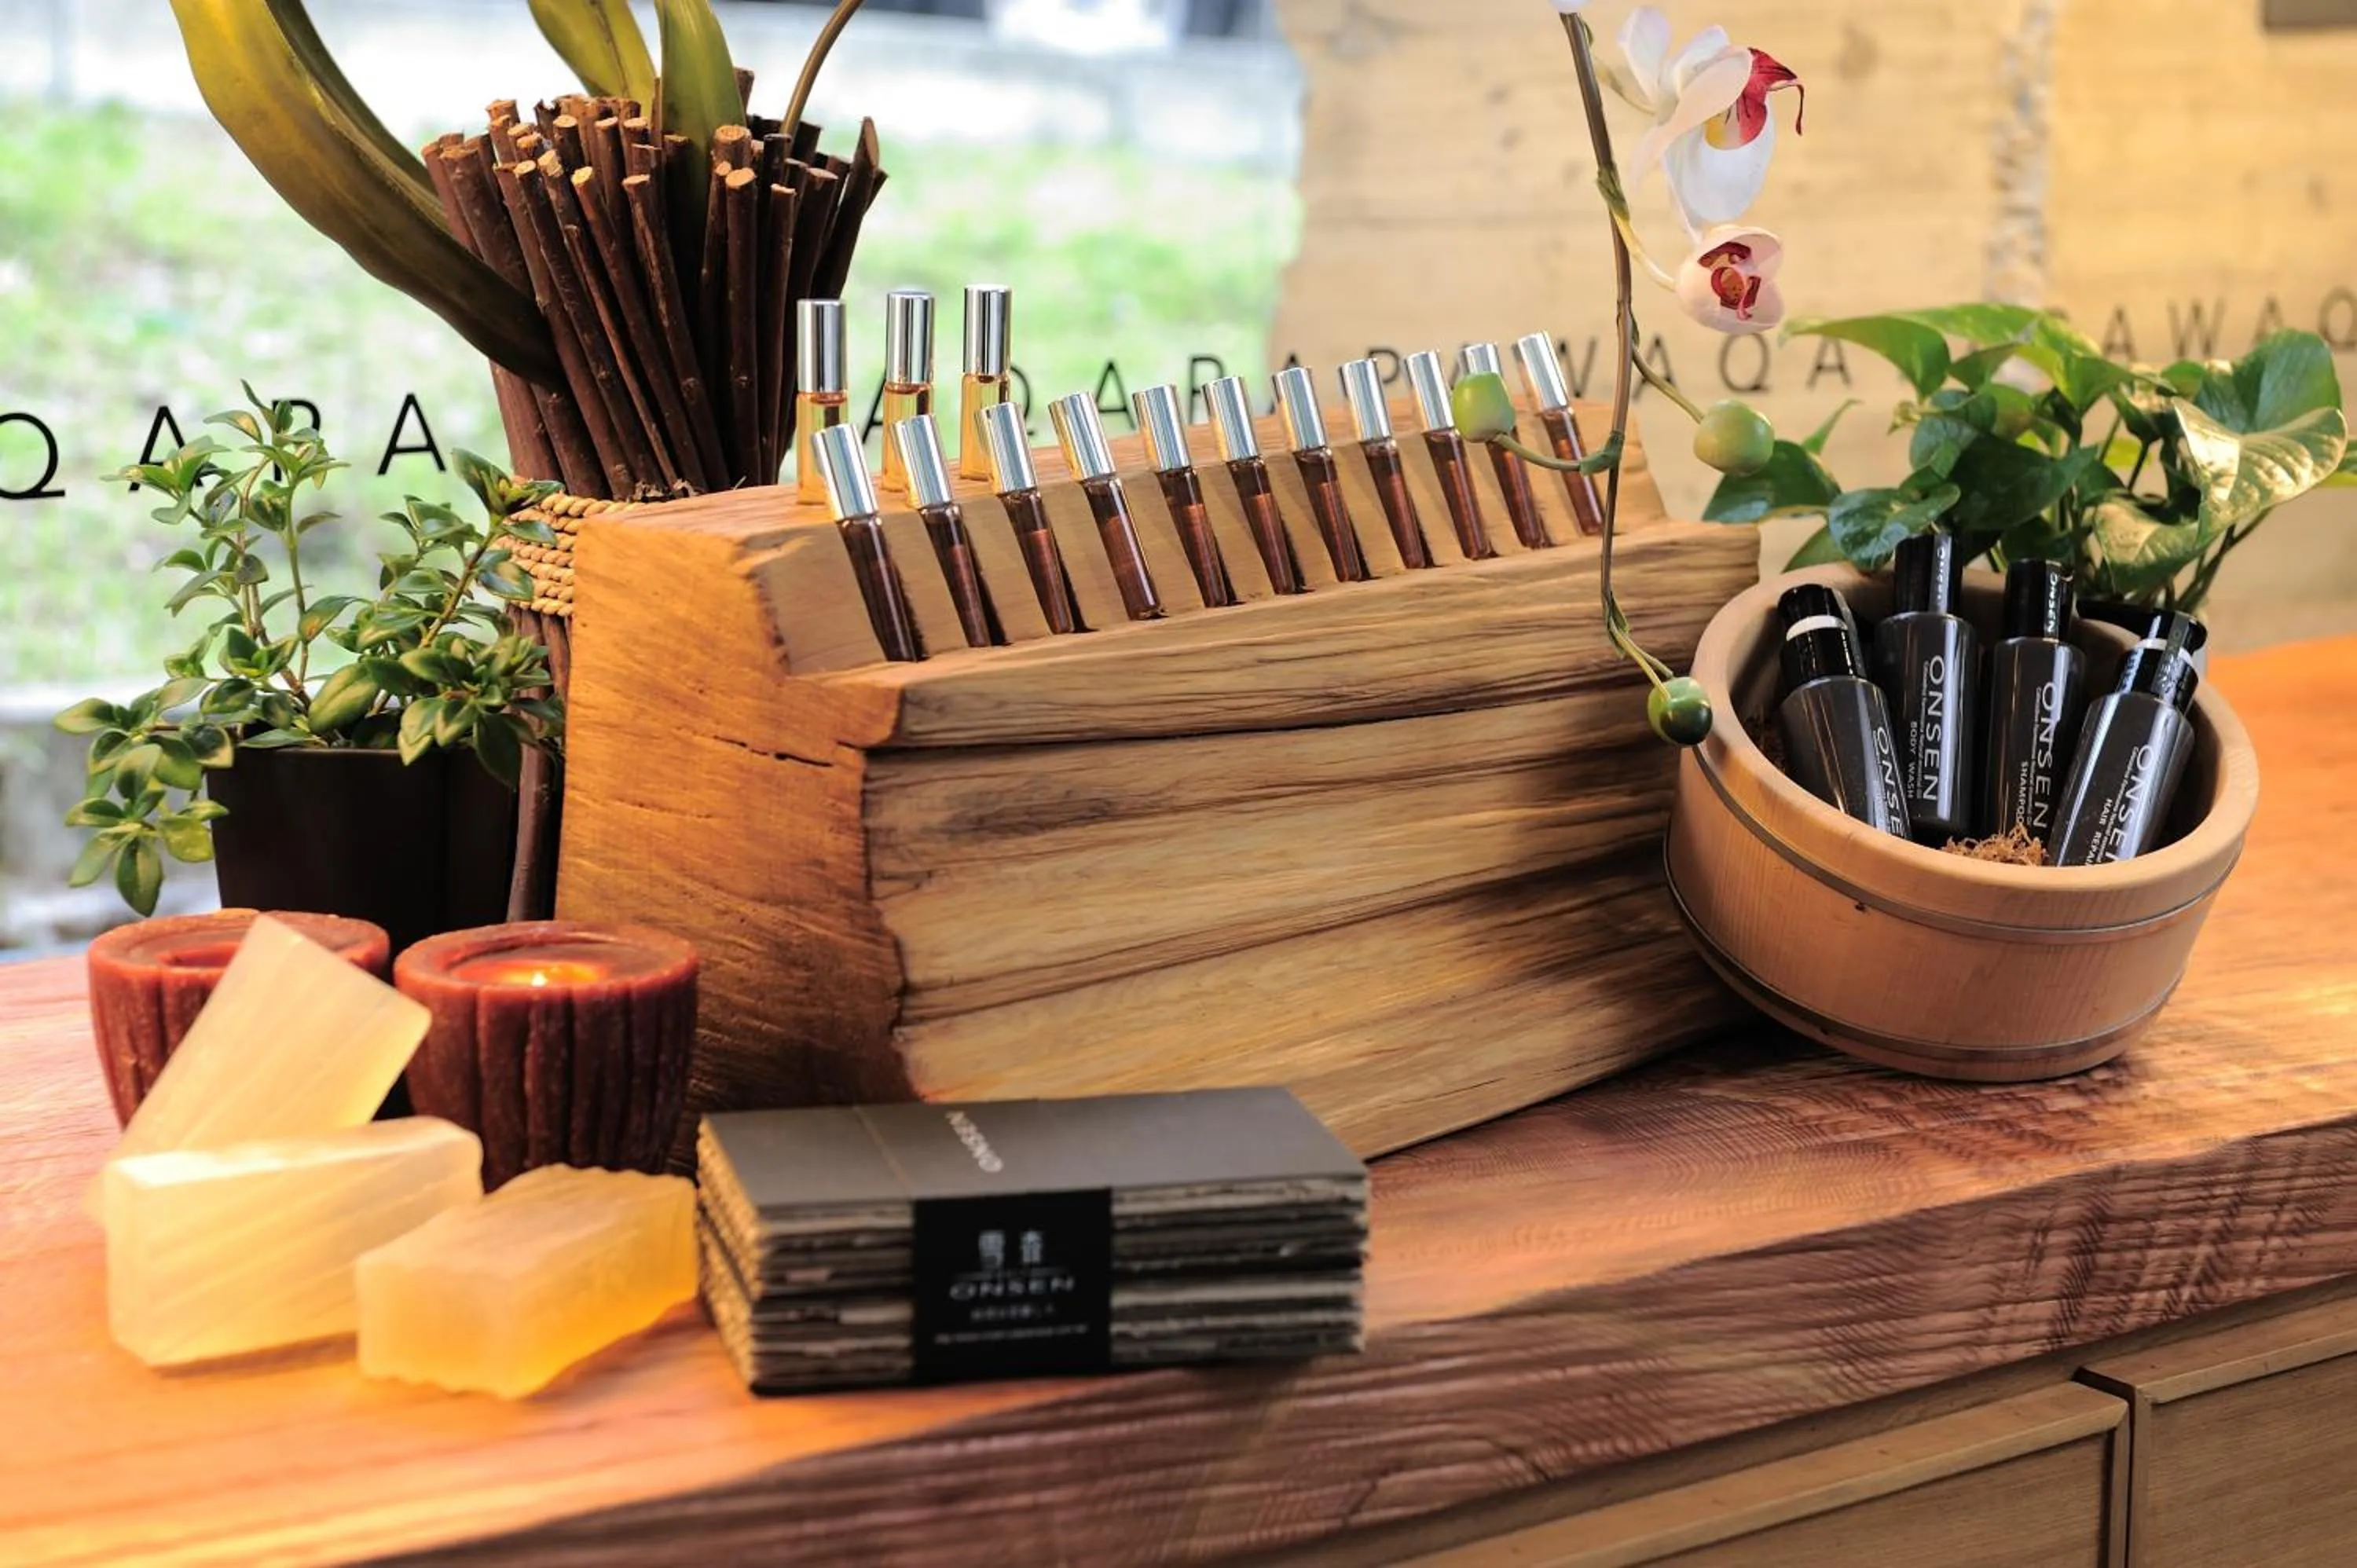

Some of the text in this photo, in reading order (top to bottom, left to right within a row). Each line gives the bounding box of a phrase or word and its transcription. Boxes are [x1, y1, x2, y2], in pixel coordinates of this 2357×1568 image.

[1923, 654, 1945, 800] ONSEN
[2033, 682, 2057, 829] ONSEN
[1877, 727, 1904, 837] ONSE
[1908, 762, 1916, 799] WASH
[2086, 797, 2113, 865] HAIR REPAI
[948, 1277, 1076, 1301] ONSEN
